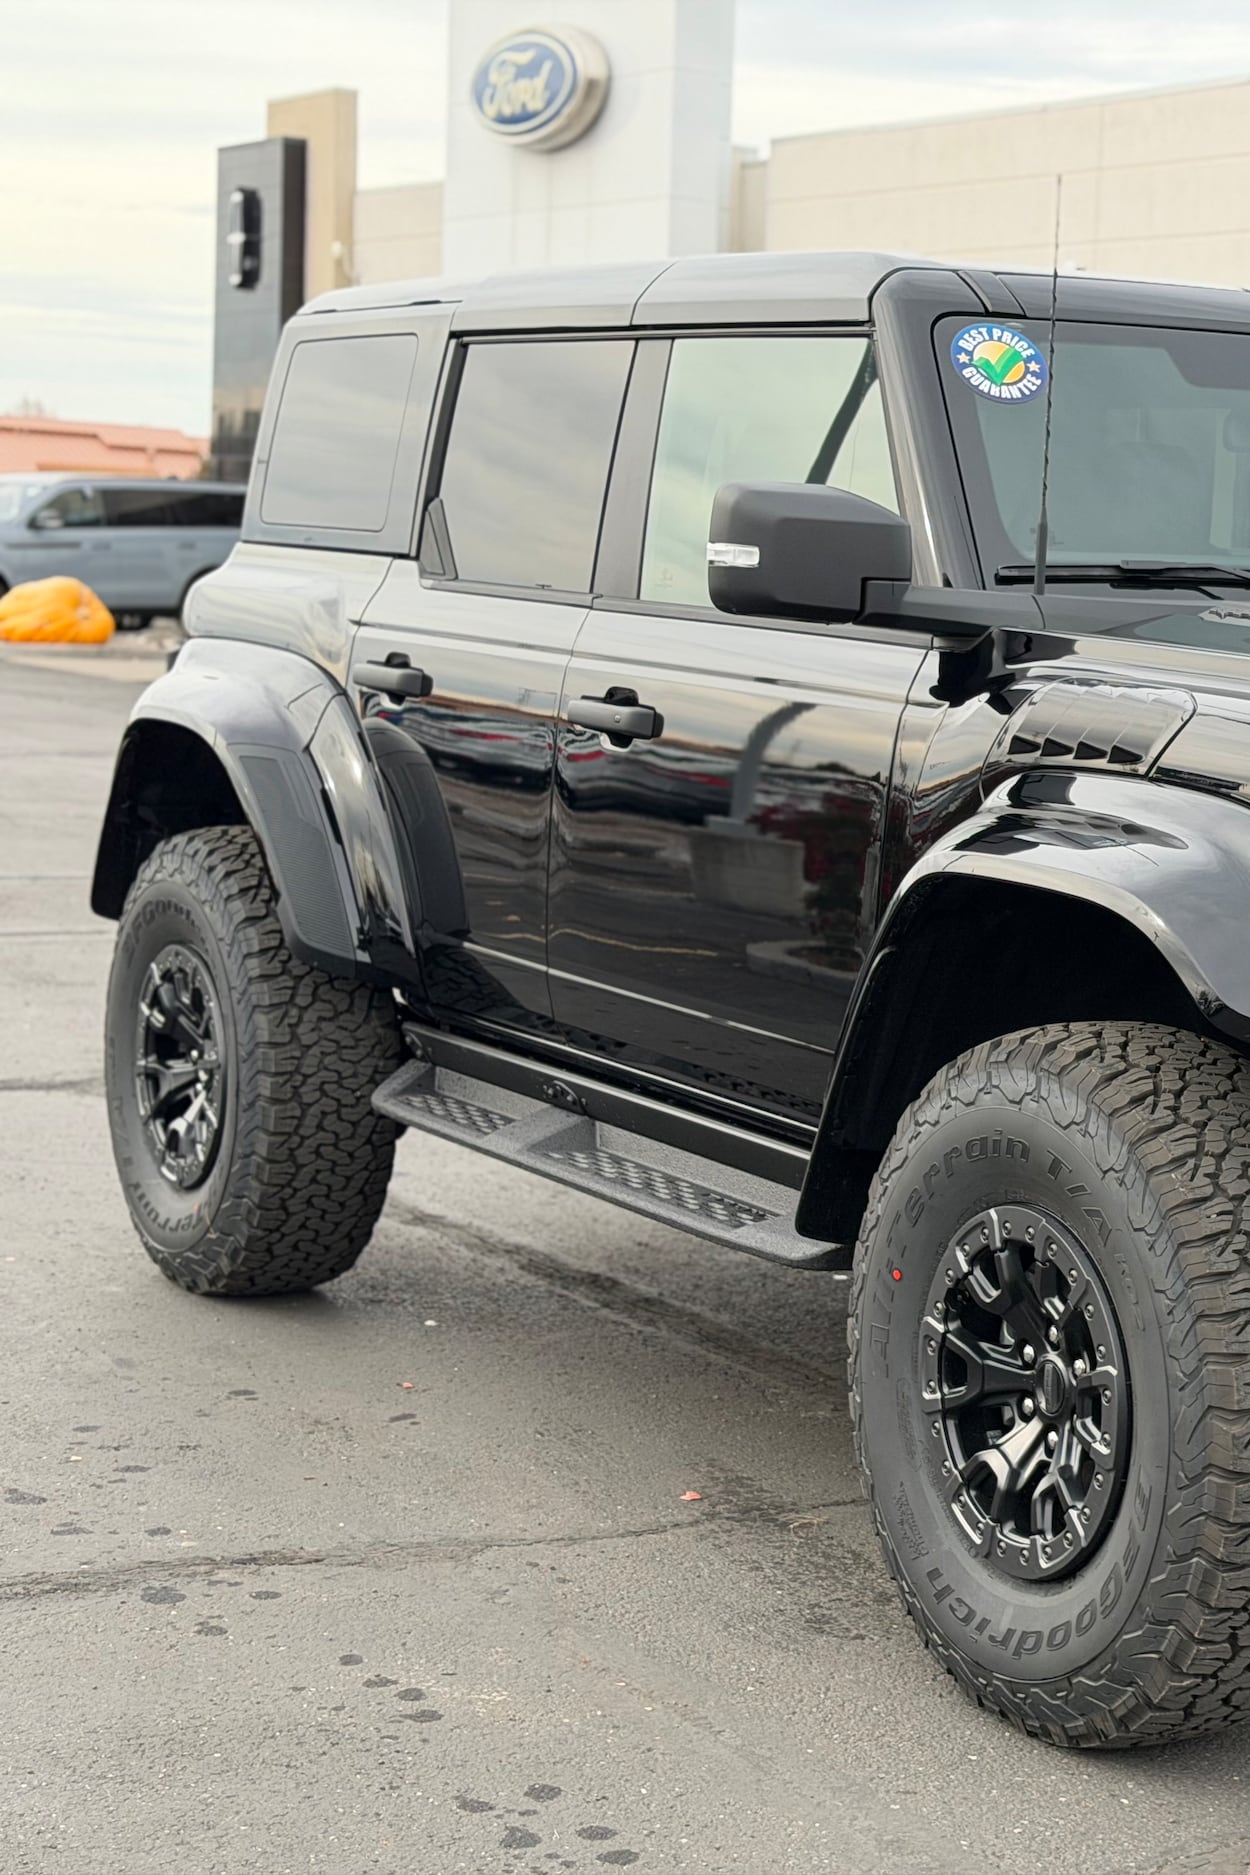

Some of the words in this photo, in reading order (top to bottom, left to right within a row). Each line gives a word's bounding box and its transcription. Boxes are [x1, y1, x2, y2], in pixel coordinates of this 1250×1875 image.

[482, 49, 552, 119] Ford
[958, 327, 990, 351] BEST
[992, 327, 1036, 359] PRICE
[962, 366, 1042, 399] GUARANTEE
[925, 1463, 1153, 1661] BFGoodrich
